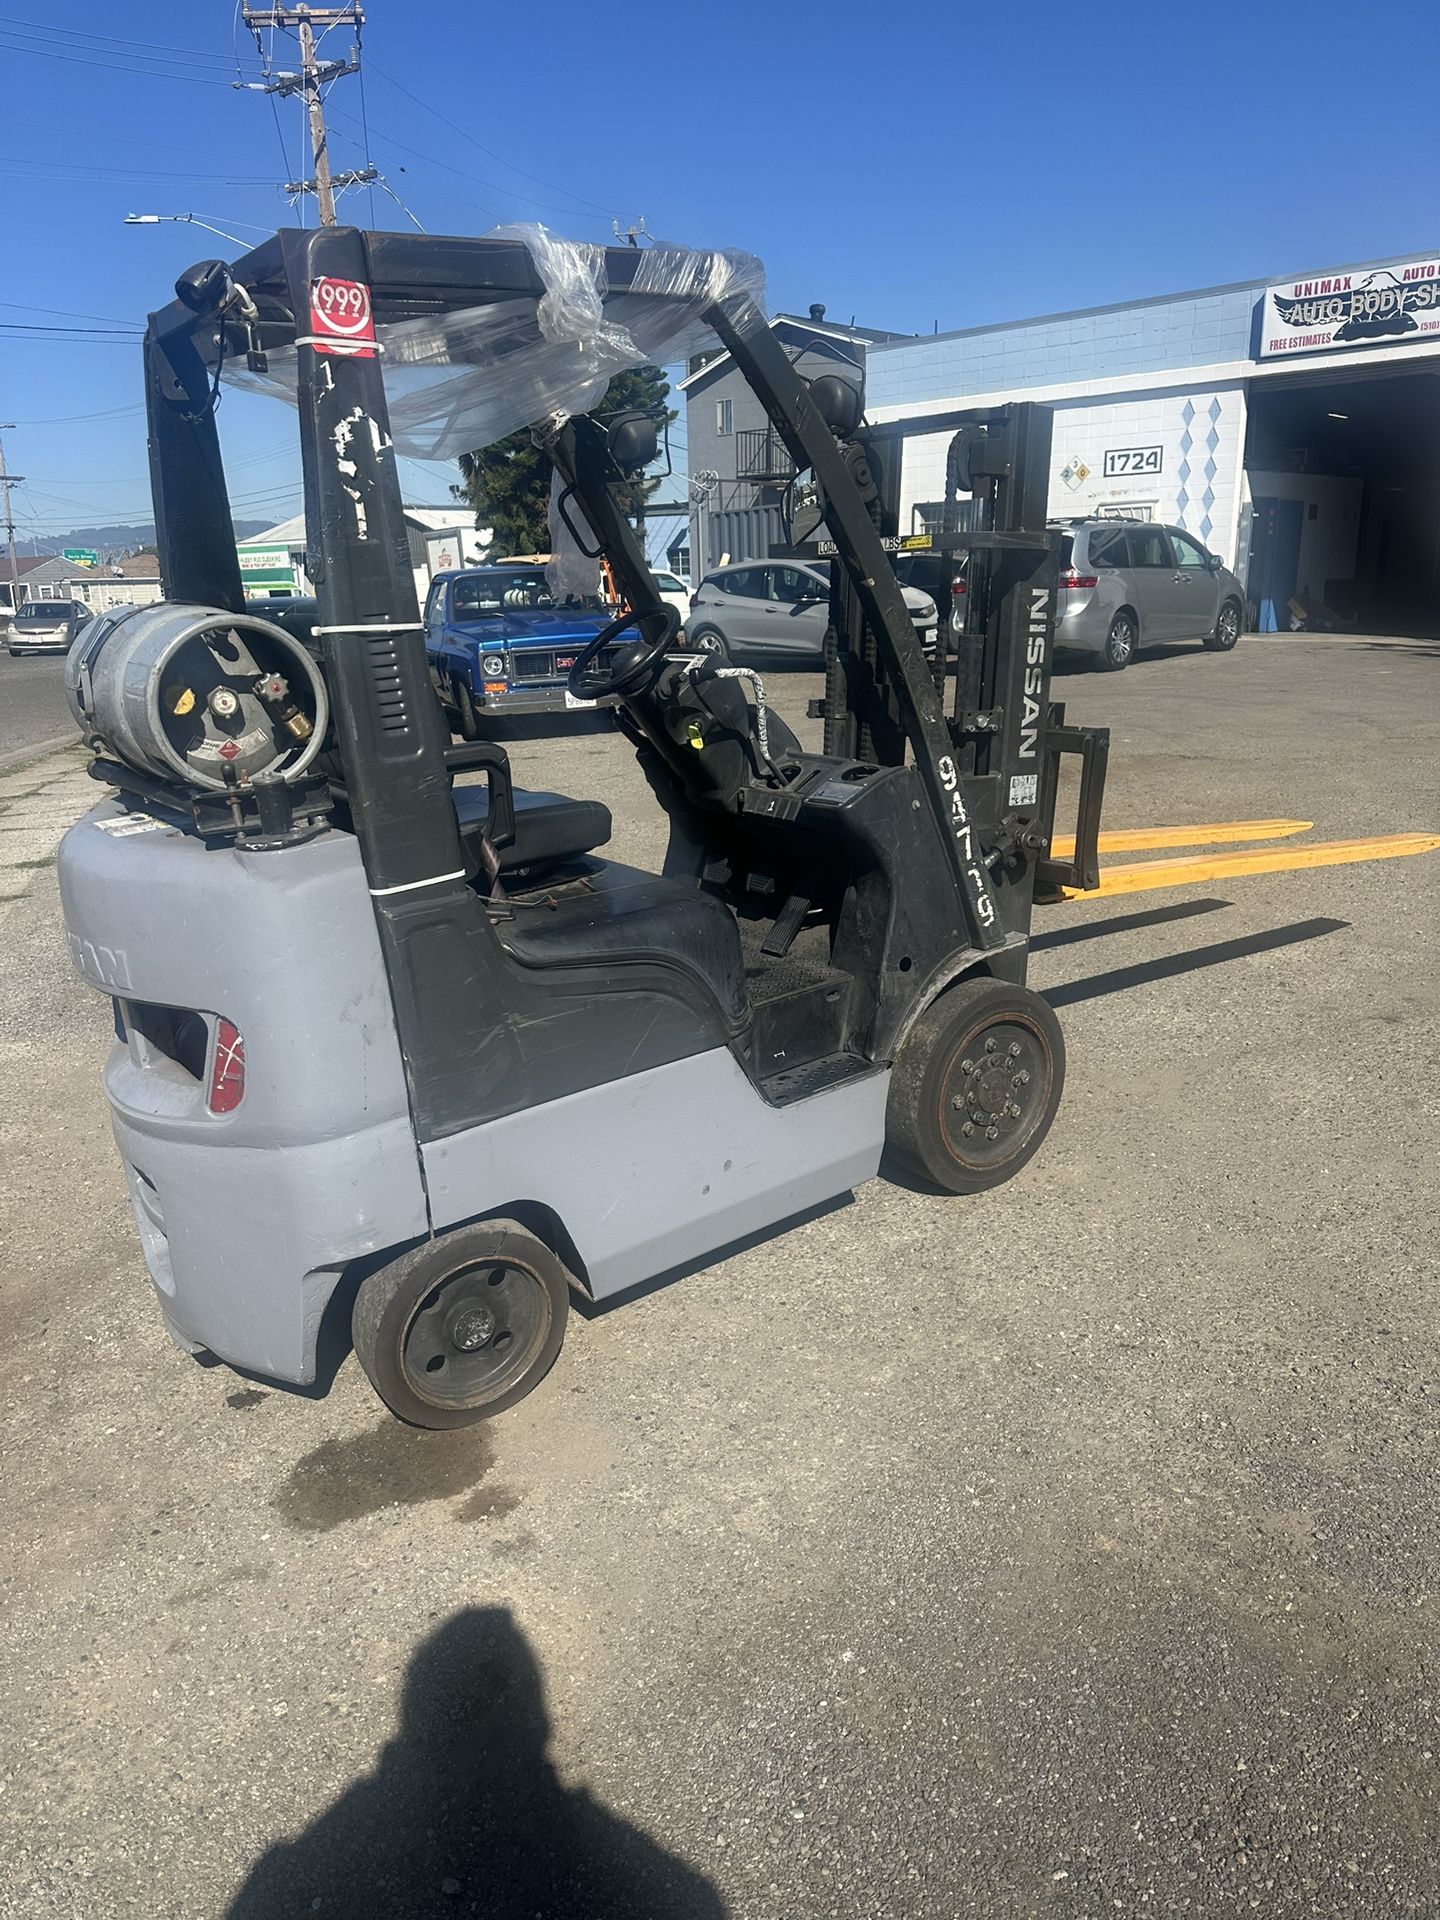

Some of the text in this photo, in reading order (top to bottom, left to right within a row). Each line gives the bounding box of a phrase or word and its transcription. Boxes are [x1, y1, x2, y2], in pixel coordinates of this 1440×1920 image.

[1403, 264, 1435, 281] AUTO
[1294, 277, 1352, 298] UNIMAX
[321, 284, 362, 318] 999
[1291, 297, 1344, 324] AUTO
[1350, 286, 1408, 315] BODY
[1420, 320, 1439, 332] (510)
[1269, 333, 1332, 351] FREE ESTIMATES
[1072, 460, 1079, 469] 3
[1109, 451, 1158, 473] 1724
[1064, 470, 1070, 478] 2
[884, 537, 900, 549] LBS
[1019, 588, 1049, 759] NISSAN
